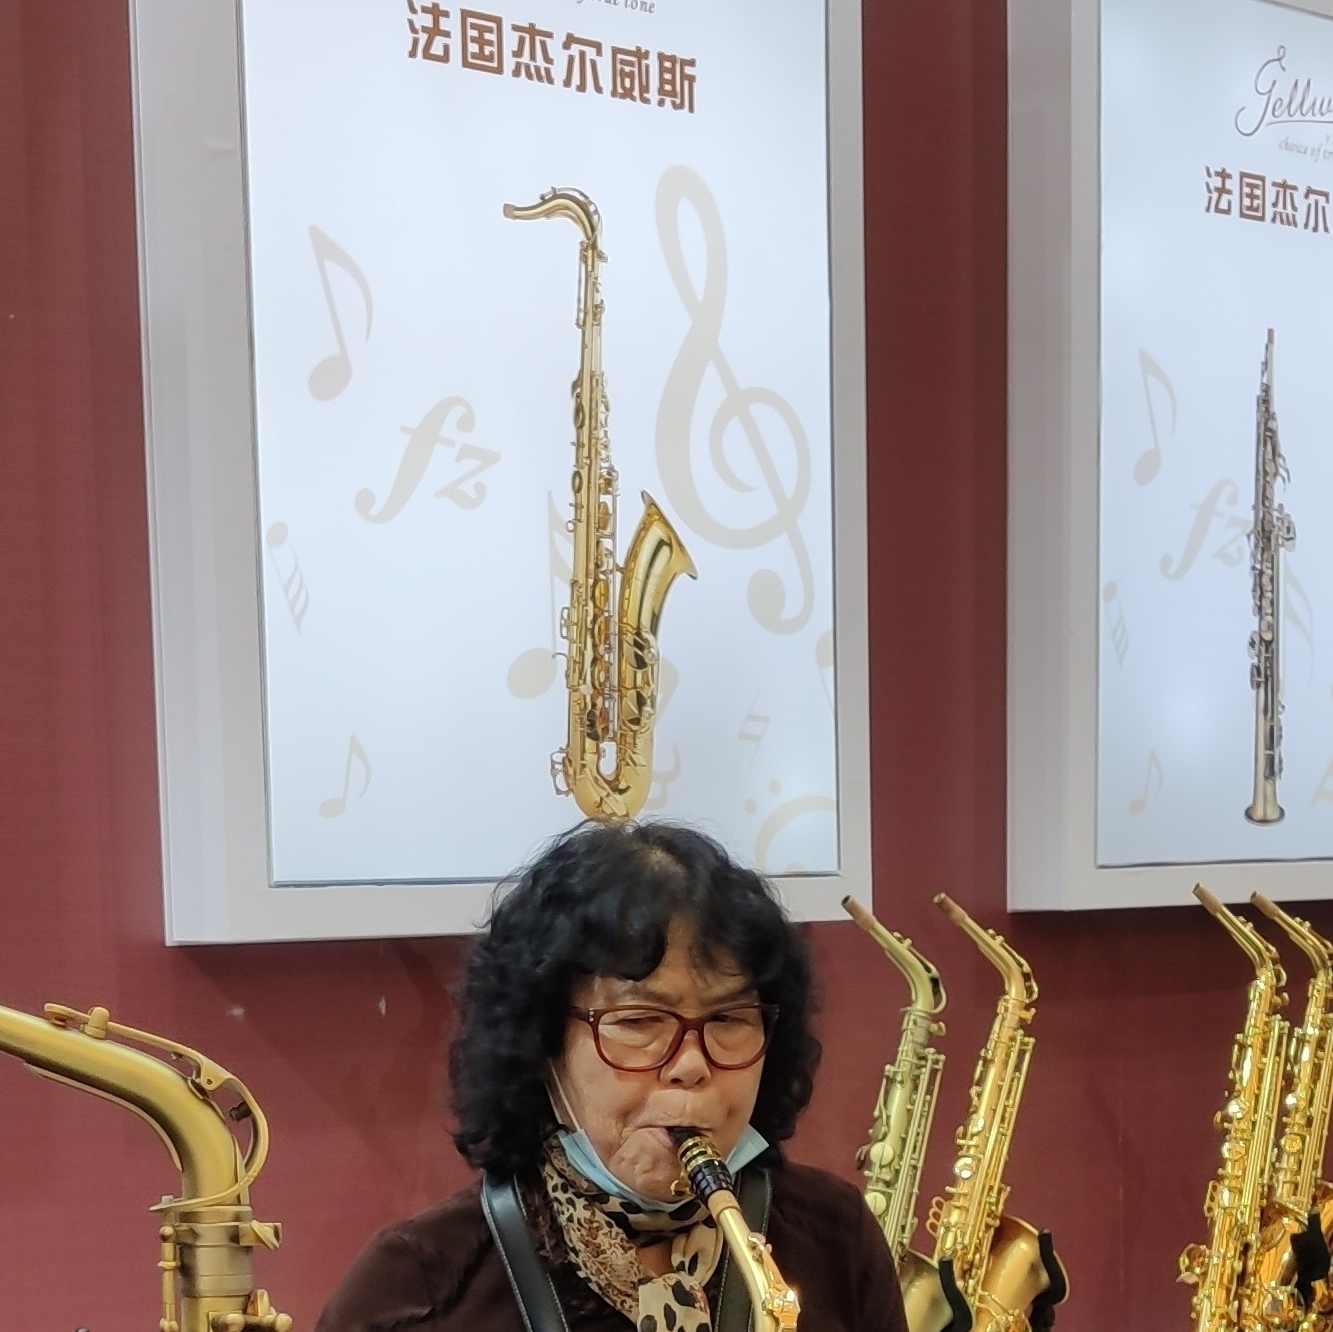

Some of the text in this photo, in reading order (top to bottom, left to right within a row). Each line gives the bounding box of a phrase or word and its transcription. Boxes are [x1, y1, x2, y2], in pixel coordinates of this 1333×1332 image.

[407, 0, 696, 114] 法国杰尔威斯
